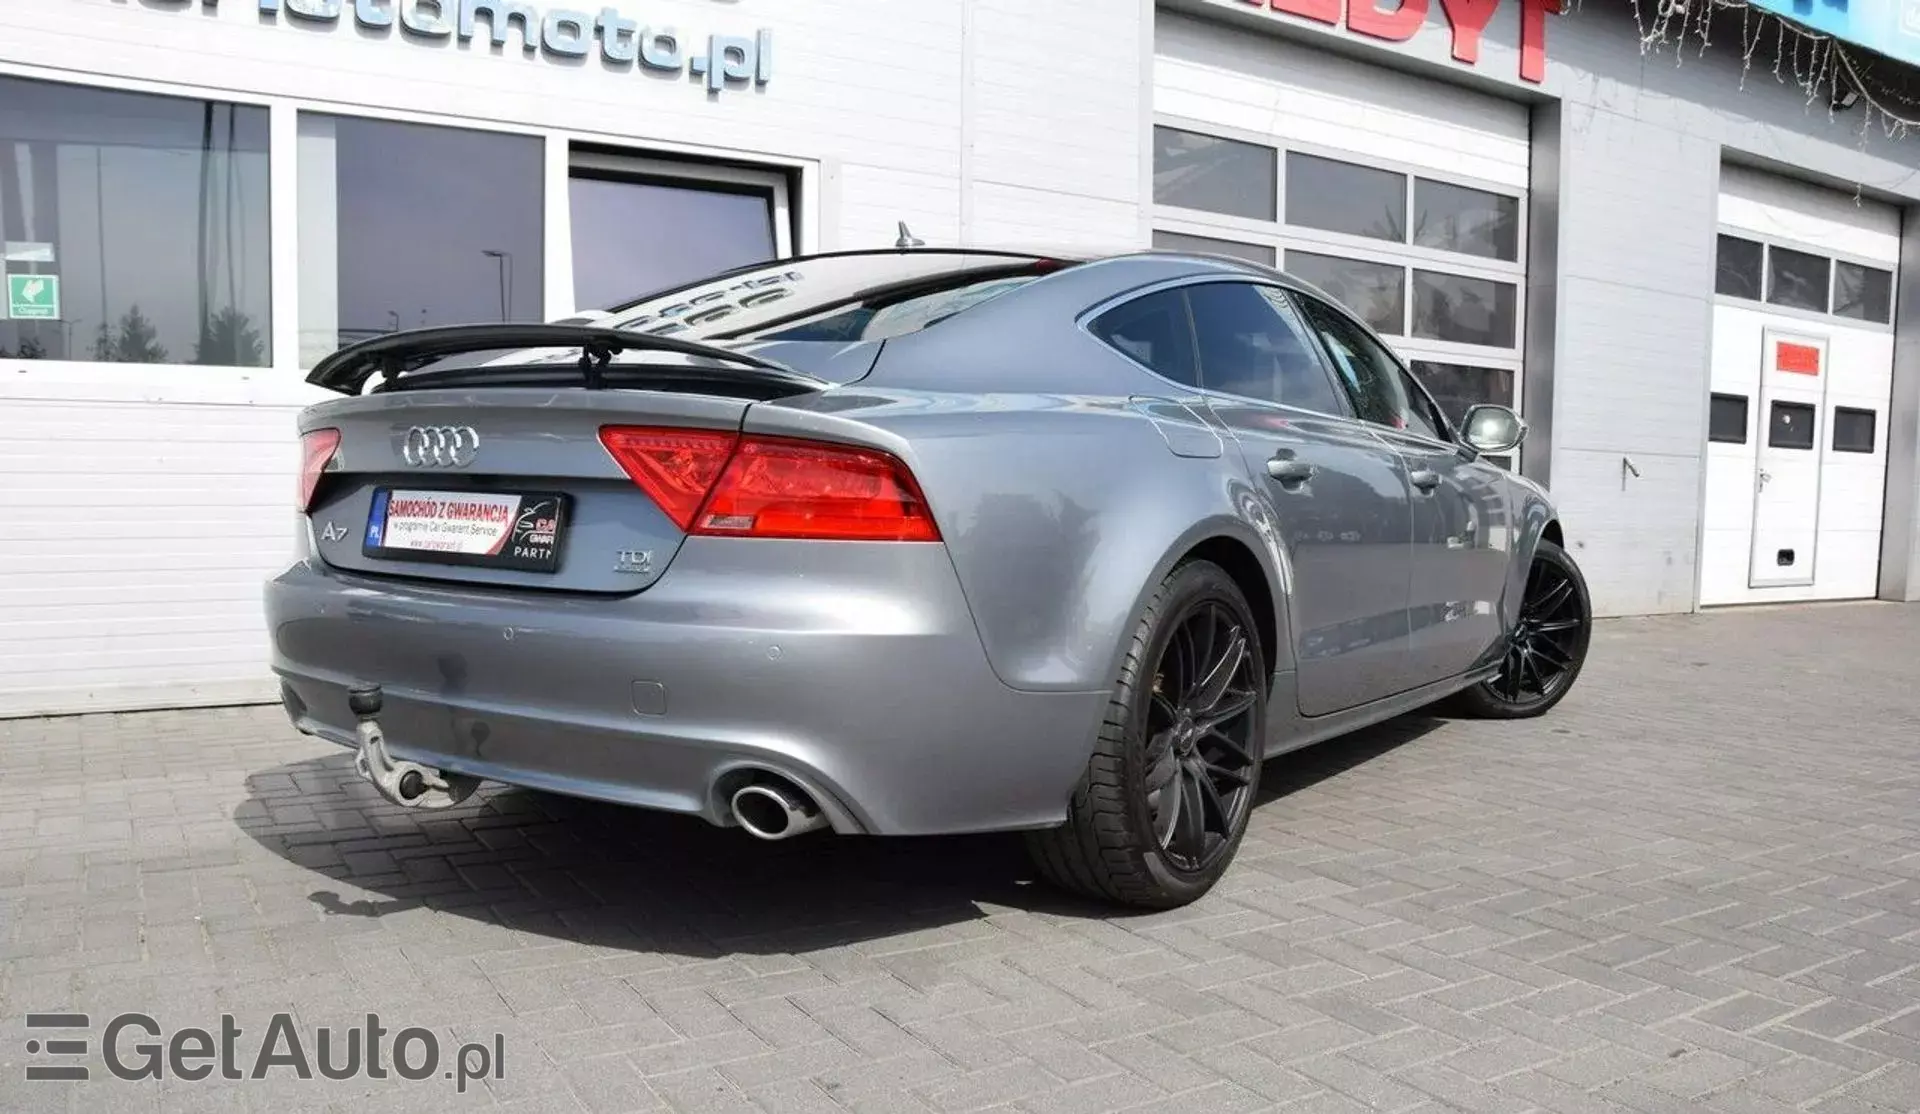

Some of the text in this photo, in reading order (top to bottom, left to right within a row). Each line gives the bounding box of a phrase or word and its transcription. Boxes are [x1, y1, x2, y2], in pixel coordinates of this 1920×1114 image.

[388, 497, 437, 518] SAMOCHÓD
[439, 502, 447, 518] Z
[320, 521, 348, 541] A7
[430, 521, 440, 532] Car
[471, 523, 498, 536] Service
[616, 550, 651, 565] TDI
